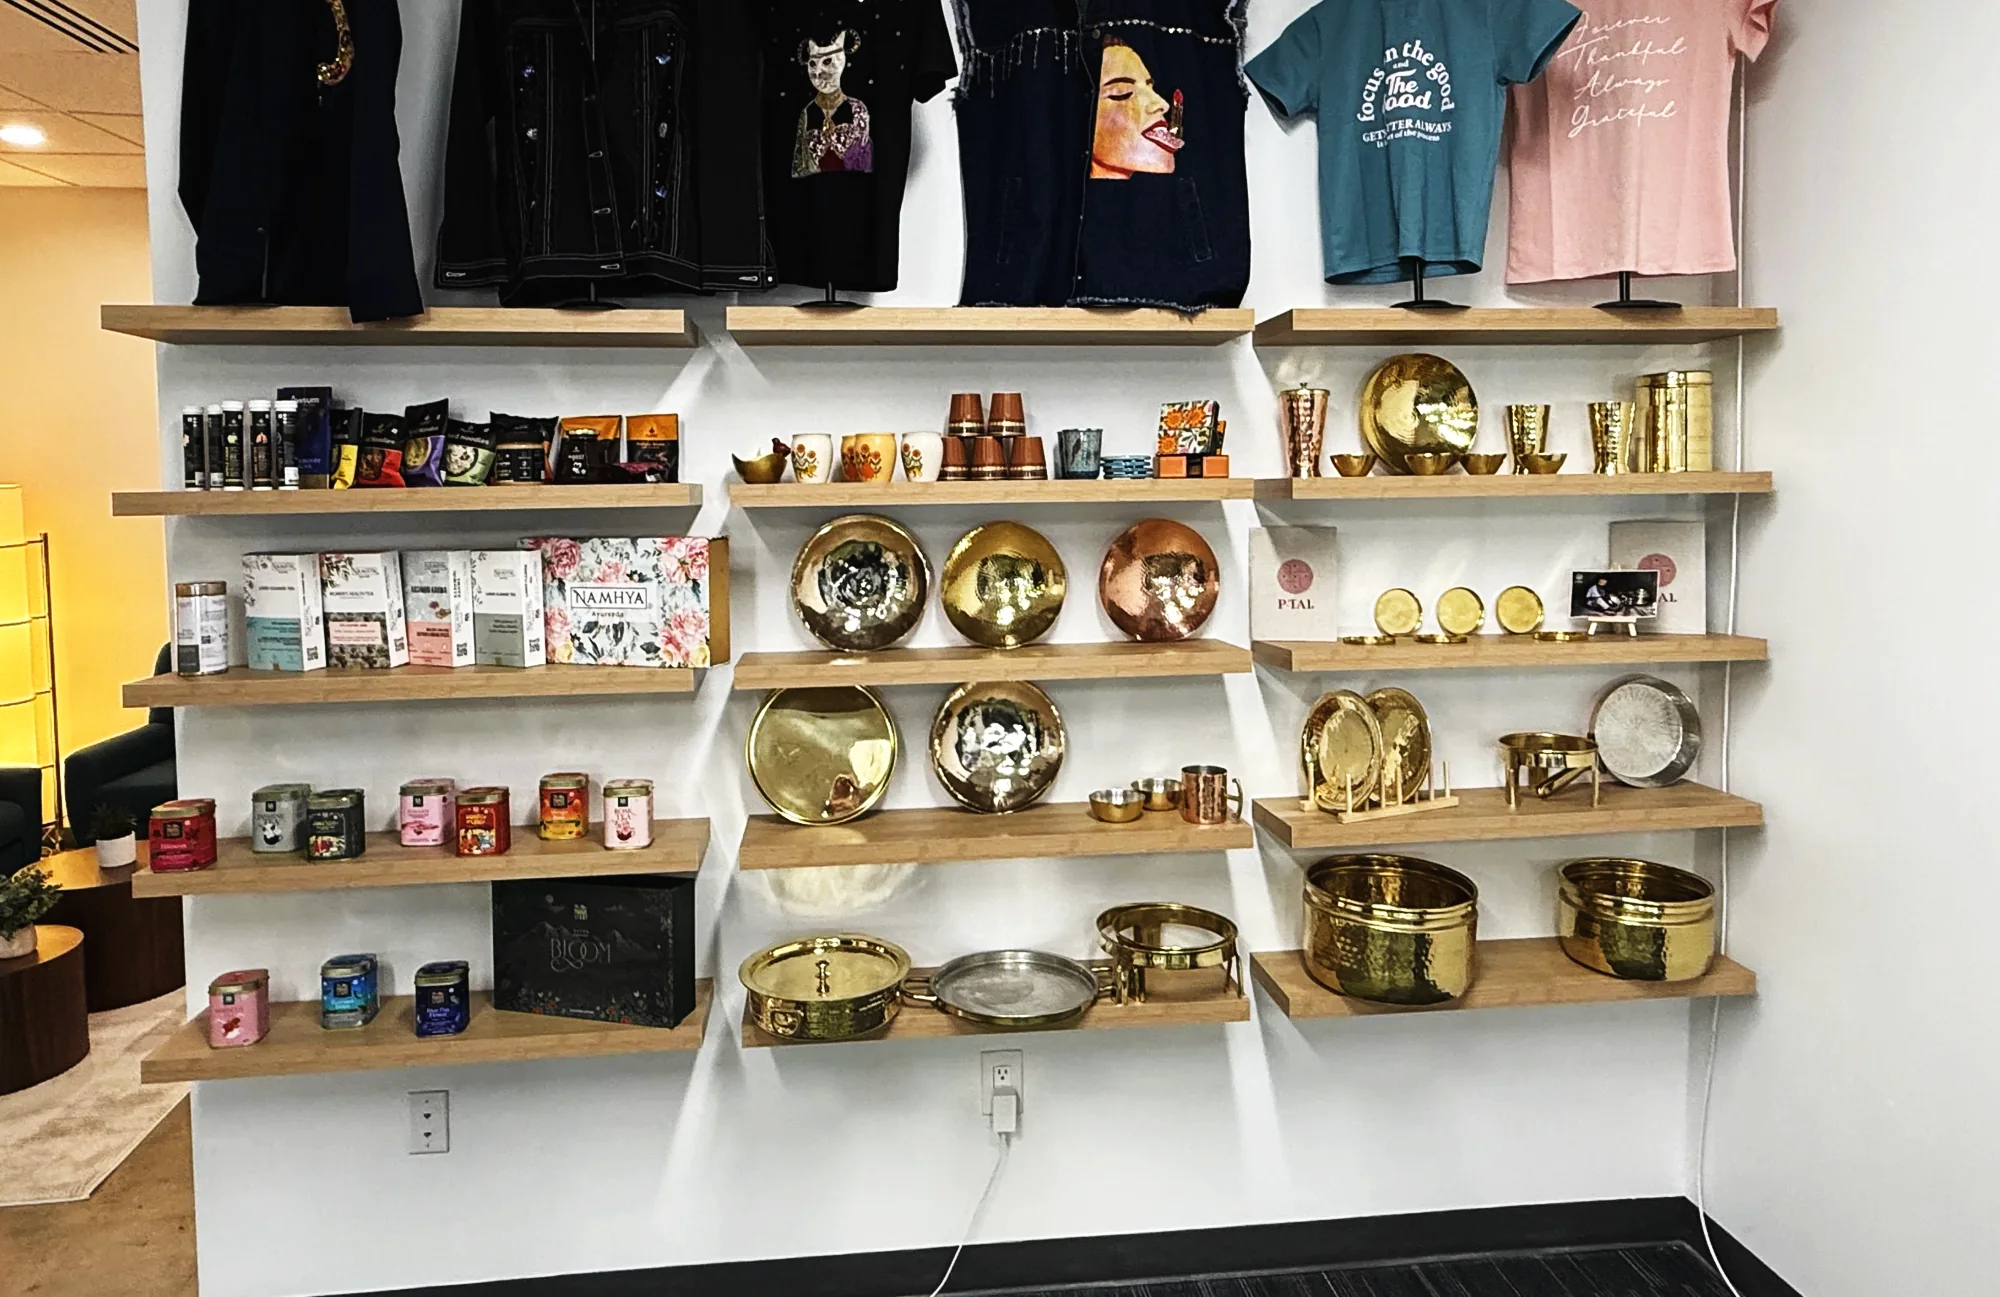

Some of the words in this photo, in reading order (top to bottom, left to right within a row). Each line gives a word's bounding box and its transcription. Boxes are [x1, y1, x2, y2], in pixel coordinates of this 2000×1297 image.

[1576, 11, 1671, 44] Forever
[1393, 59, 1409, 69] and
[1557, 36, 1688, 72] Thankful
[1357, 67, 1385, 122] focus
[1384, 46, 1399, 63] n
[1402, 39, 1434, 66] the
[1426, 62, 1455, 112] good
[1385, 68, 1418, 96] The
[1573, 70, 1670, 101] Always
[1415, 120, 1452, 134] ALWAYS
[1568, 100, 1677, 138] Grateful
[572, 589, 644, 607] NAMHYA
[550, 938, 611, 972] BLOOM
